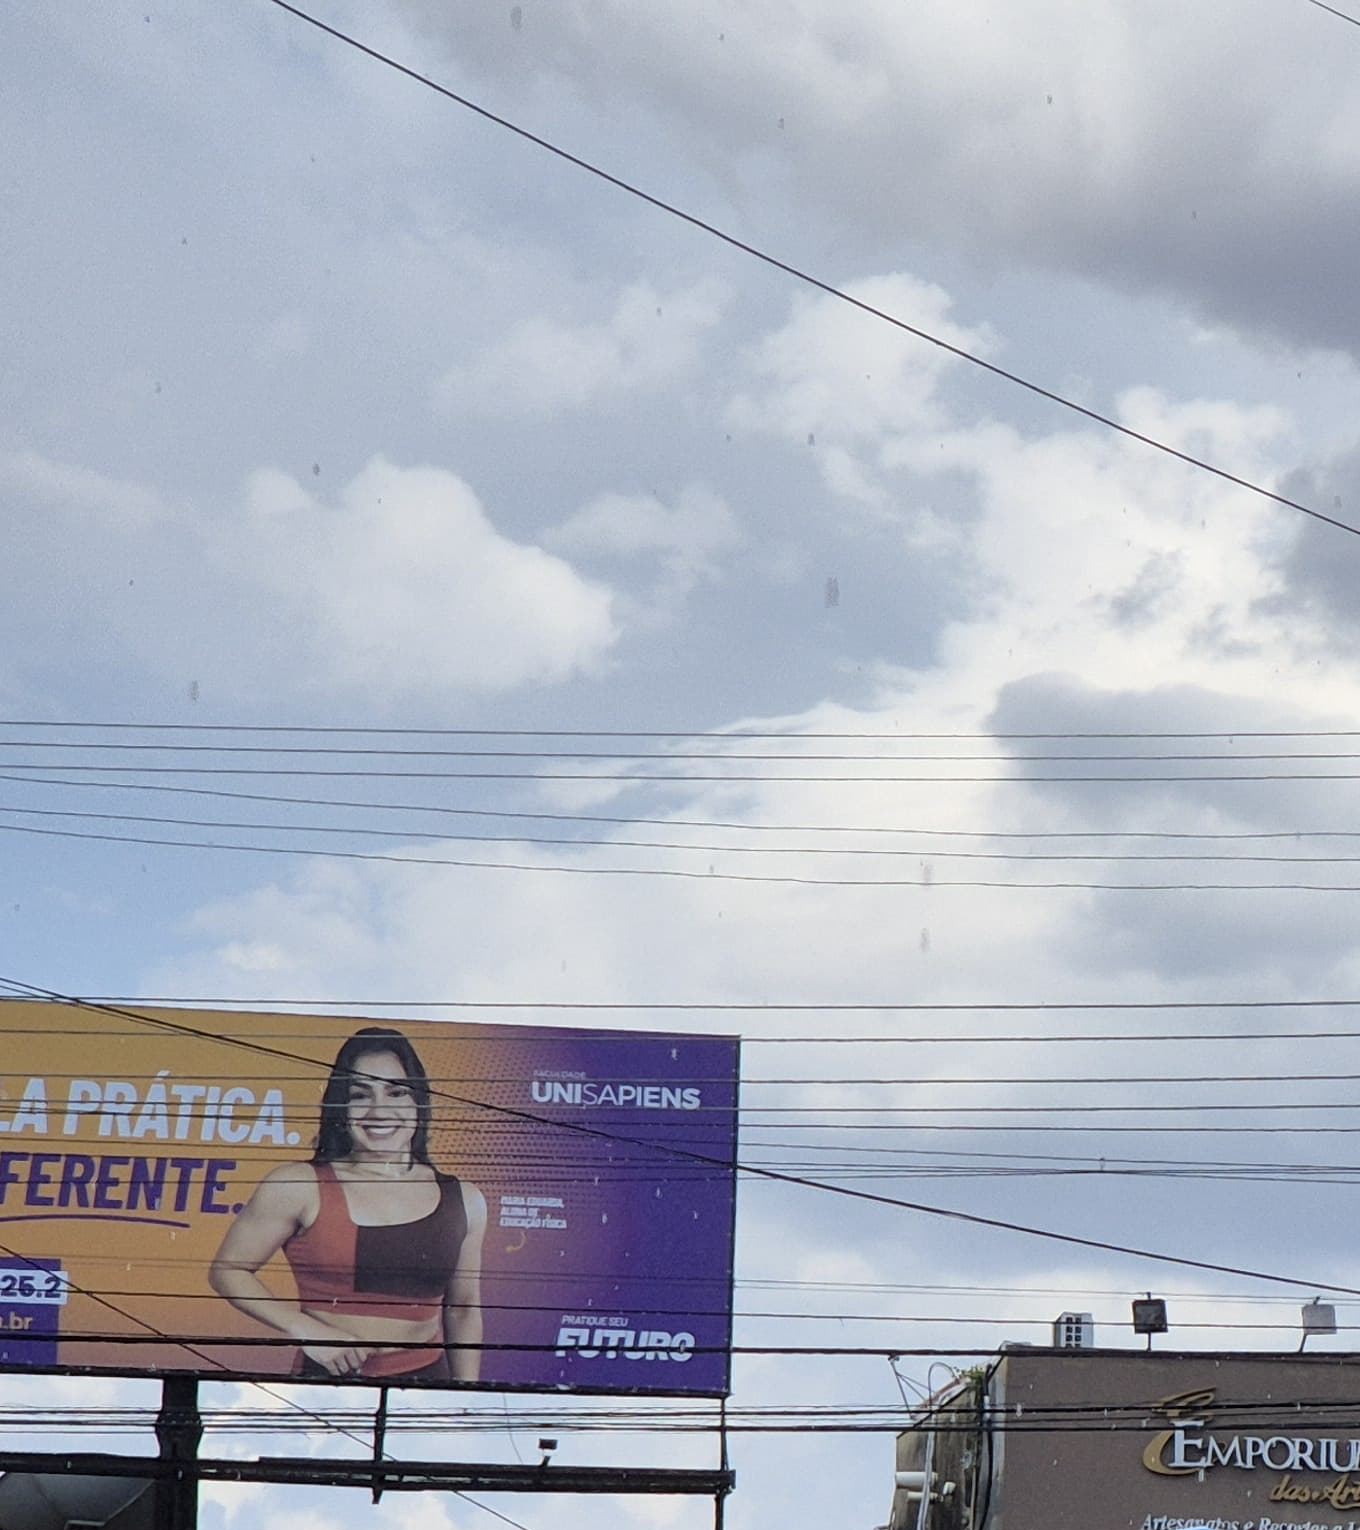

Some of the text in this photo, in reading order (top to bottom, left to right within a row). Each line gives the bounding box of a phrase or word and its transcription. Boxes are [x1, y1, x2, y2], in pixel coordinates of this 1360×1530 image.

[63, 1069, 300, 1145] PRÁTICA.
[531, 1081, 701, 1110] UNISAPIENS
[608, 1317, 630, 1327] SEU
[555, 1328, 695, 1362] FUTURO
